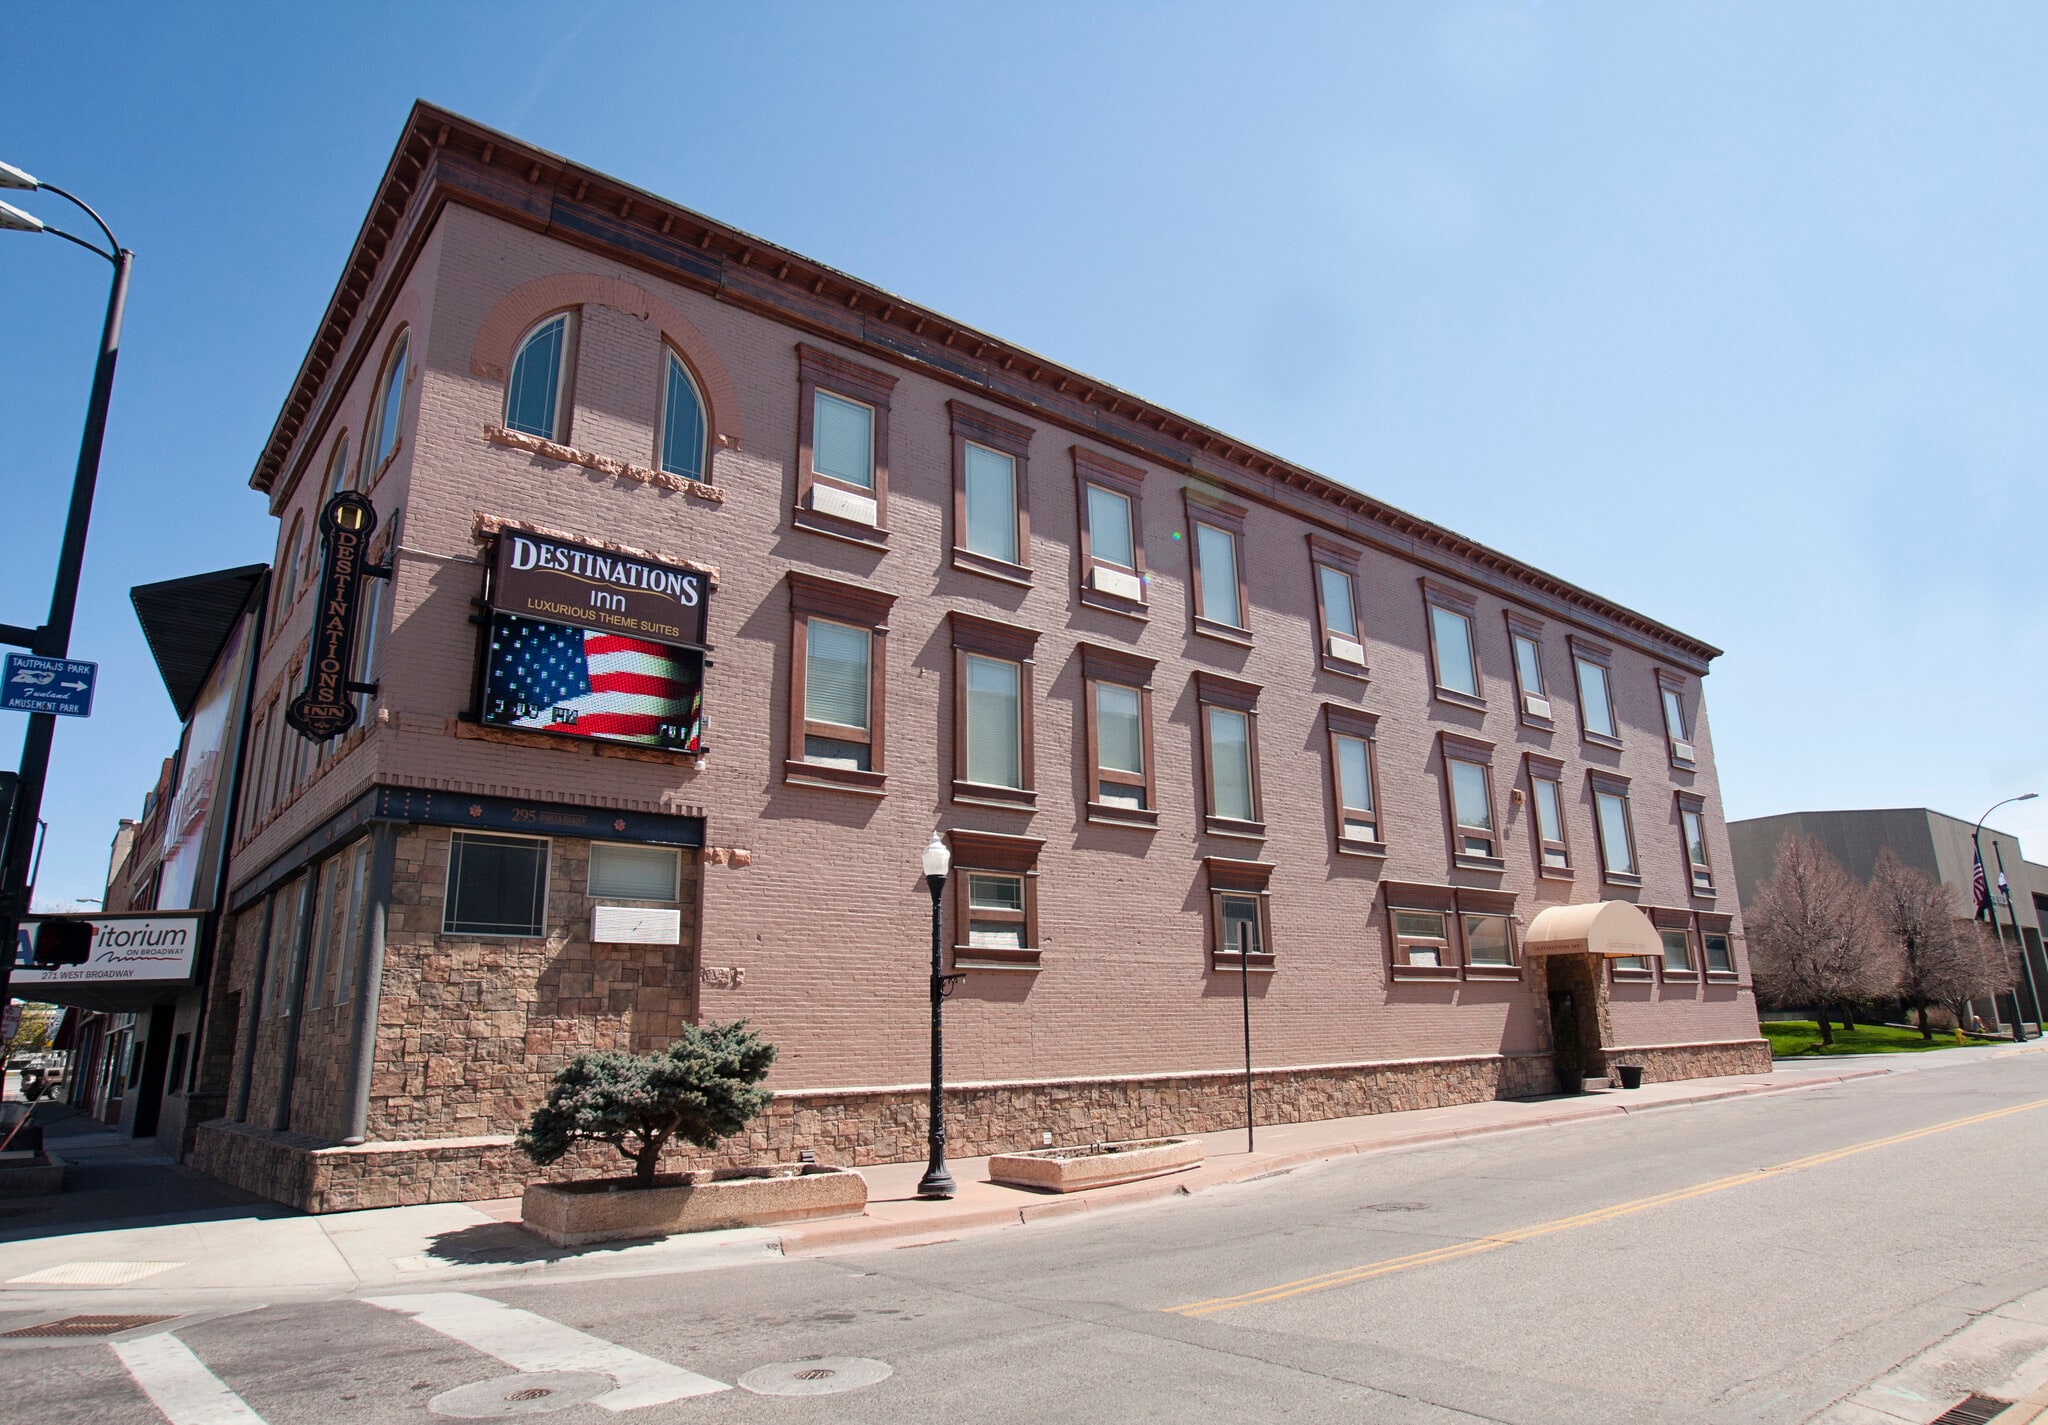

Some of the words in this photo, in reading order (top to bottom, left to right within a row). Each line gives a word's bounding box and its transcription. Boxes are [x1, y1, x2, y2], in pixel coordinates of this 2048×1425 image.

[511, 537, 699, 607] DESTINATIONS
[318, 531, 358, 702] DESTINATIONS
[527, 597, 596, 621] LUXURIOUS
[600, 612, 638, 630] THEME
[641, 621, 680, 637] SUITES
[12, 657, 64, 671] TAUTPHAUS
[67, 664, 91, 675] PARK
[23, 687, 72, 699] Funland
[8, 698, 57, 711] AMUSEMENT
[59, 703, 80, 713] PARK
[303, 705, 345, 718] INN
[511, 808, 537, 824] 295
[539, 811, 588, 827] BROADWAY
[41, 972, 58, 980] 271
[60, 971, 85, 979] WEST
[85, 970, 135, 979] BROADWAY
